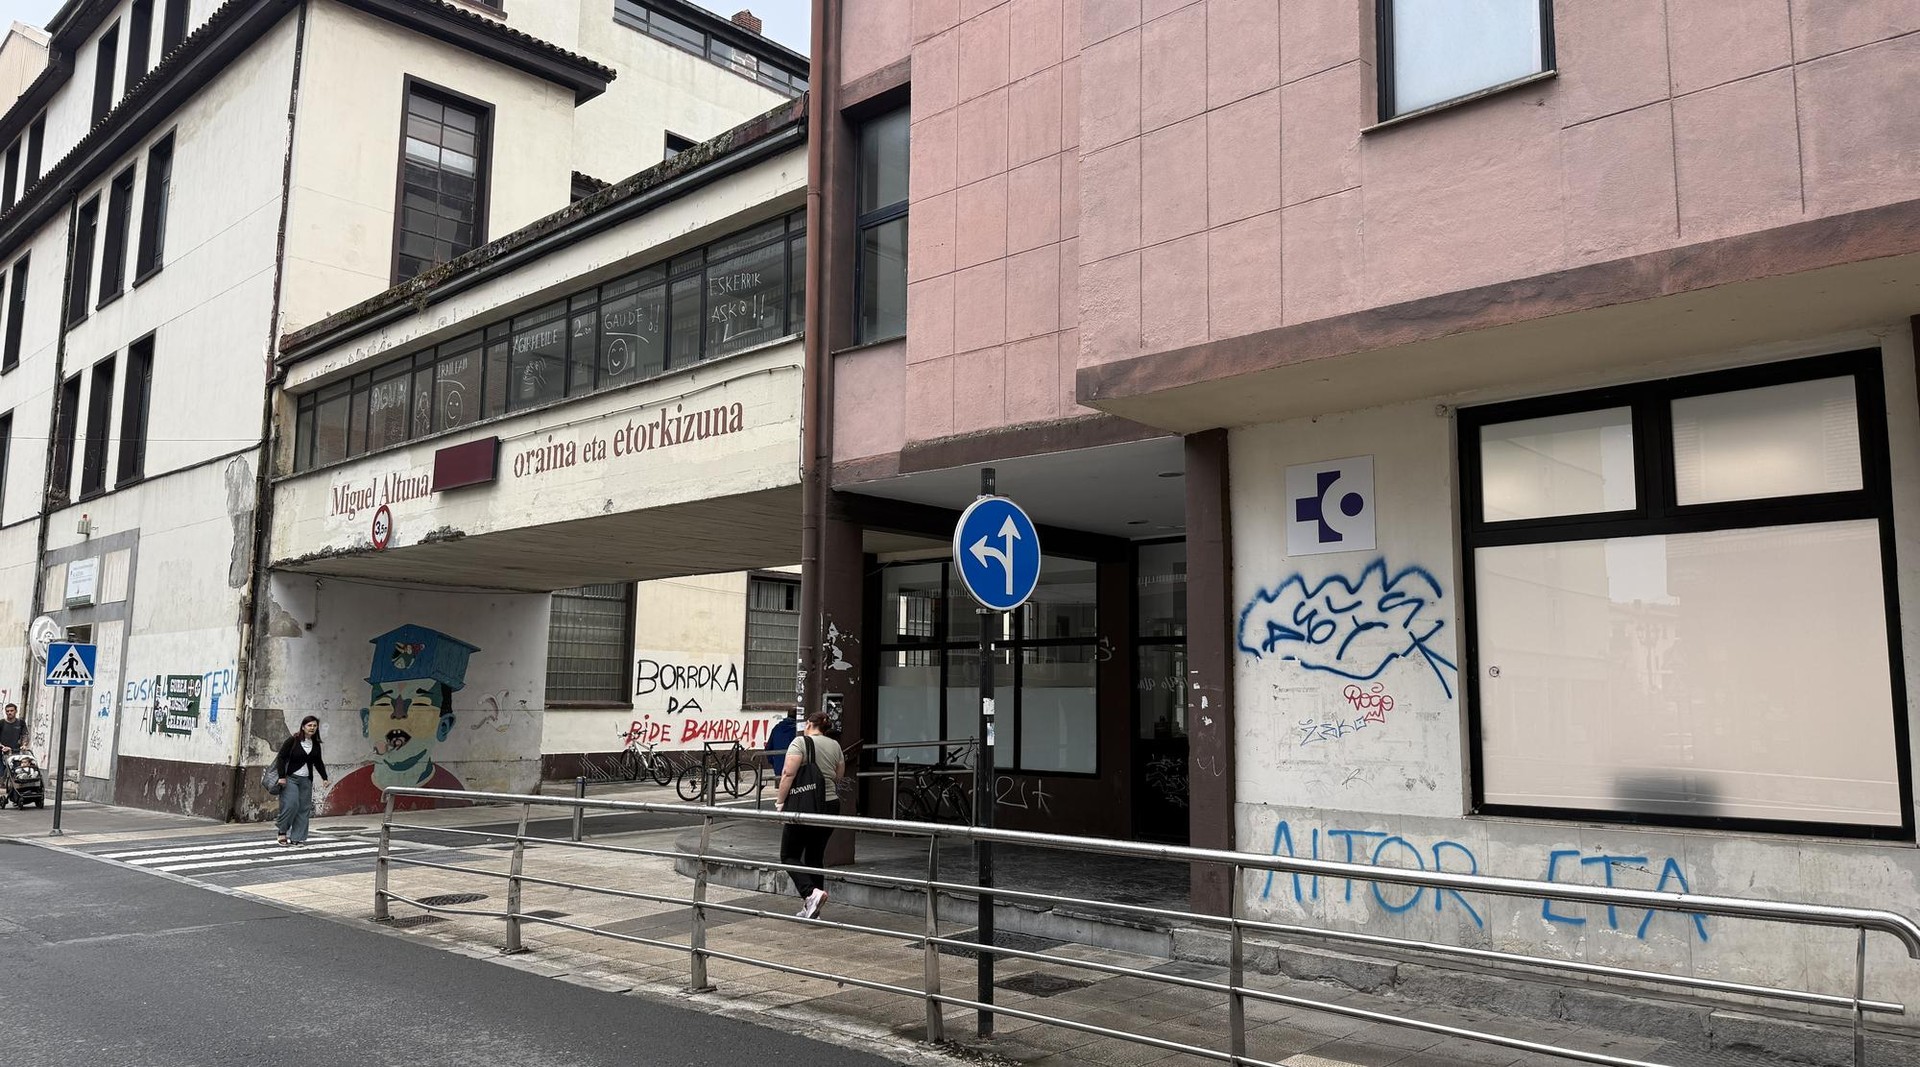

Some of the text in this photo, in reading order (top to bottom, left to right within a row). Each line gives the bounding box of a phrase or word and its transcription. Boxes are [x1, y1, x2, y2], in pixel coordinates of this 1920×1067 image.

[708, 272, 761, 298] ESKERRIK
[604, 307, 643, 330] GAUDE
[331, 478, 377, 521] Miguel
[513, 434, 576, 478] oraina
[583, 436, 607, 463] eta
[613, 401, 744, 457] etorkizuna
[636, 659, 739, 696] BORROKA
[667, 696, 703, 714] DA
[1262, 820, 1708, 943] AITOR ETA
